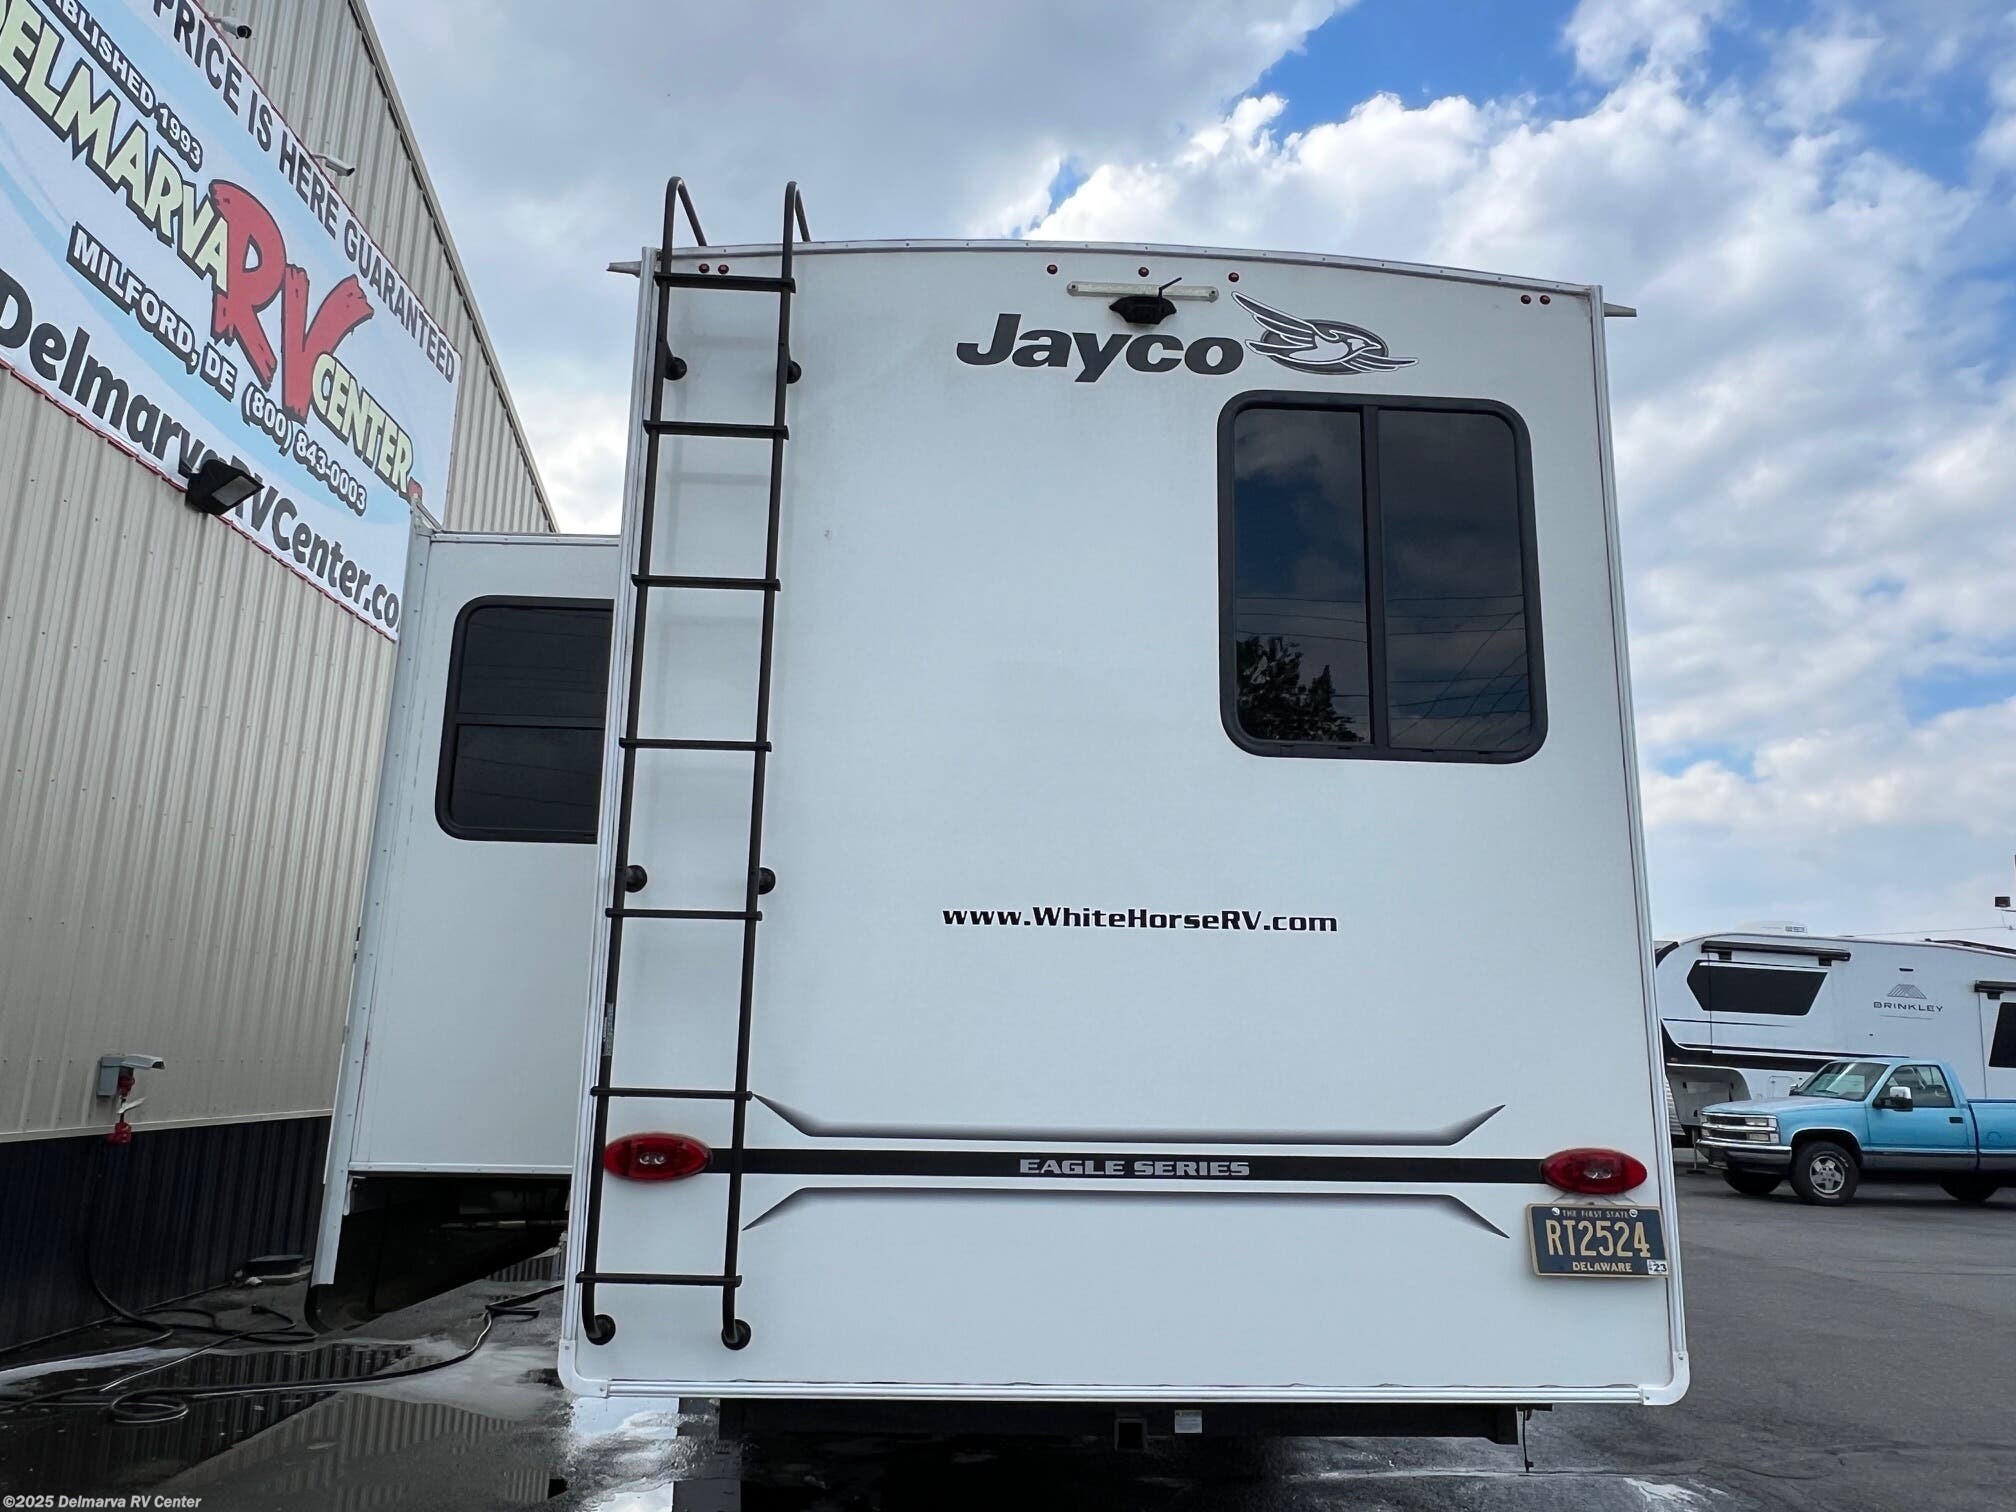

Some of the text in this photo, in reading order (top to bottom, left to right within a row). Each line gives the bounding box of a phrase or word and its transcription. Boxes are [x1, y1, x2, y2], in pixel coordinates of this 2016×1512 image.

[160, 109, 201, 165] 1993
[248, 90, 273, 152] IS
[279, 130, 339, 239] HERE
[343, 218, 456, 383] GUARANTEED
[209, 178, 374, 425] RV
[312, 353, 413, 495] CENTER
[957, 313, 1243, 382] Jayco
[73, 228, 367, 511] MILFORD, DE (800) 843-0003
[943, 906, 1338, 932] www.WhiteHorseRV.com
[1873, 1001, 1943, 1012] BRINKLEY
[1019, 1159, 1250, 1176] EAGLE SERIES
[1546, 1220, 1651, 1257] RT2524
[1573, 1261, 1632, 1272] DELAWARE
